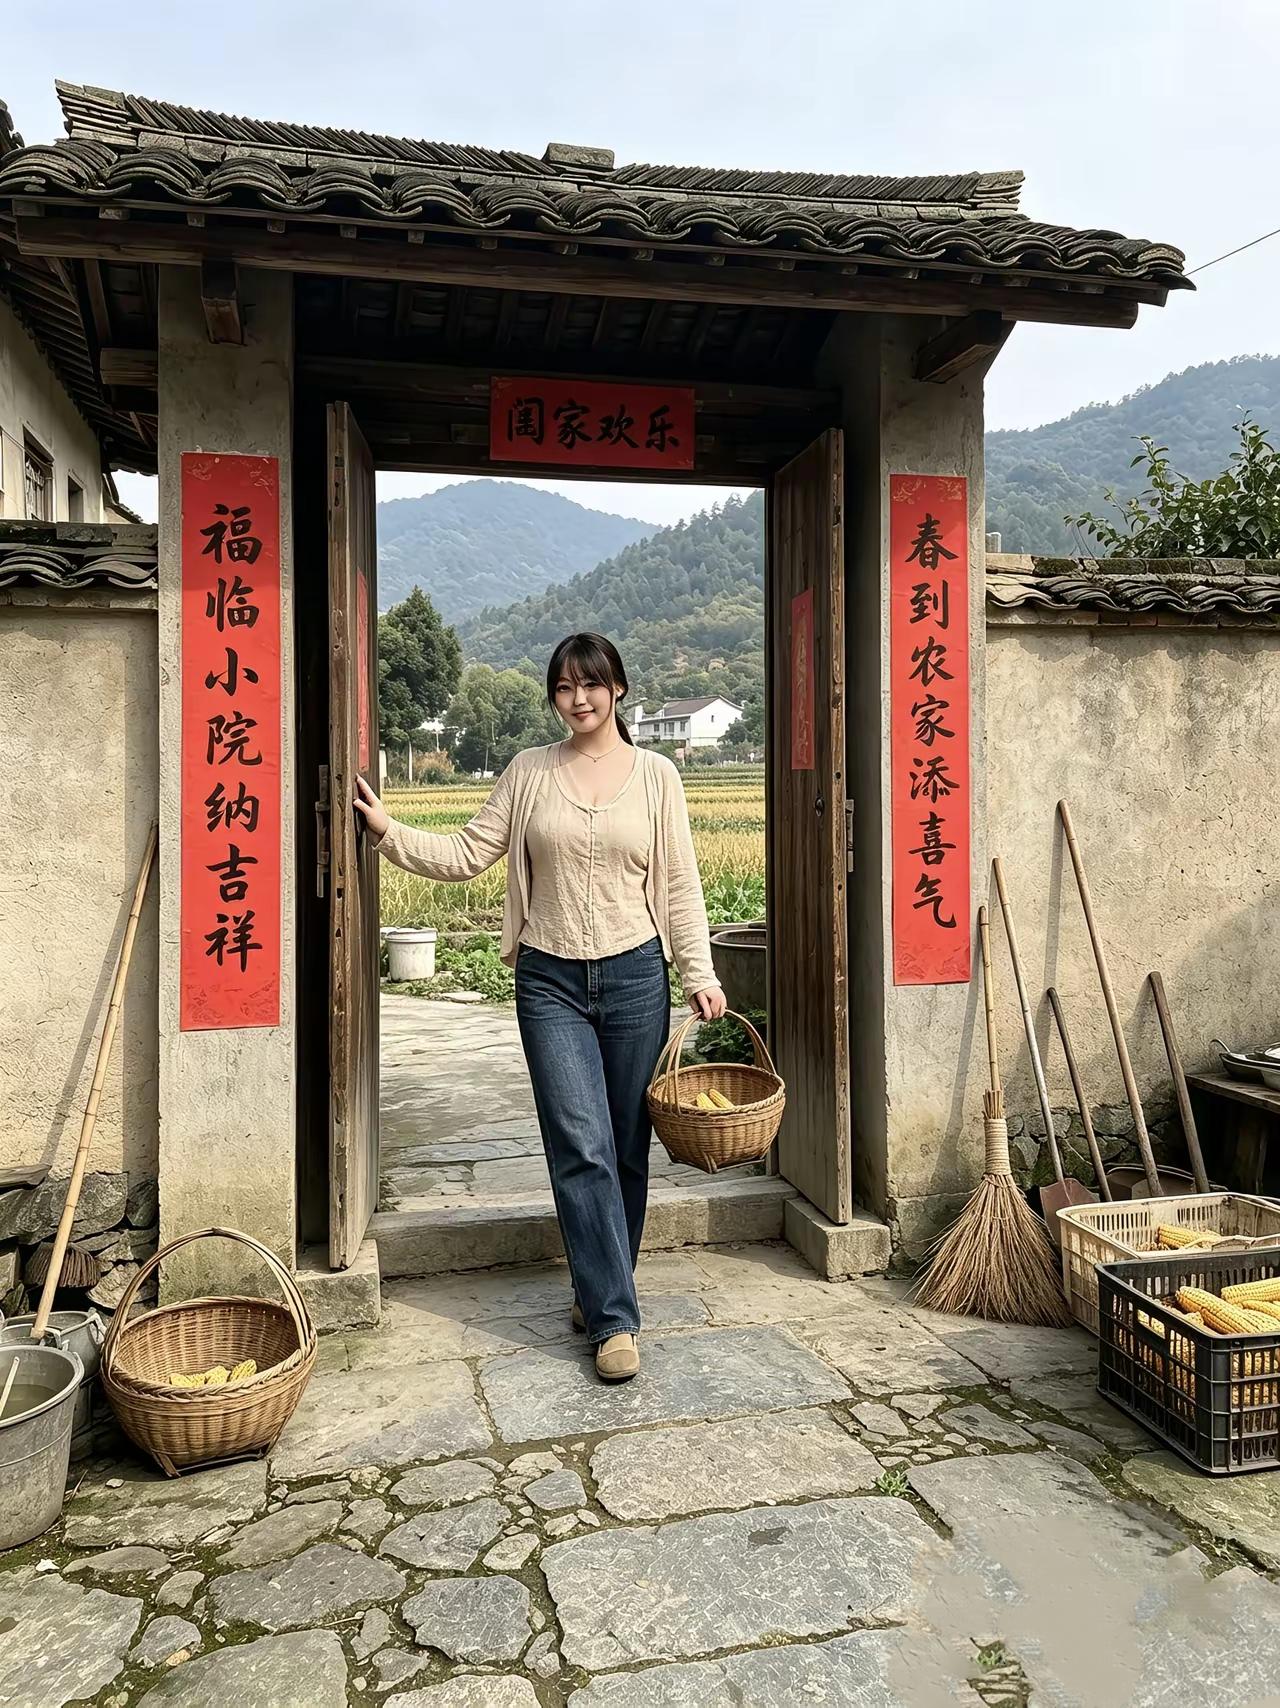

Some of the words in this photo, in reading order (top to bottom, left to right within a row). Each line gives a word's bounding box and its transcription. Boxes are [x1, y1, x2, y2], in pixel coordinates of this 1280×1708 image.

[507, 396, 680, 453] 阖家欢乐
[199, 503, 263, 973] 福临小院纳吉祥
[905, 512, 960, 930] 春到农家添喜气
